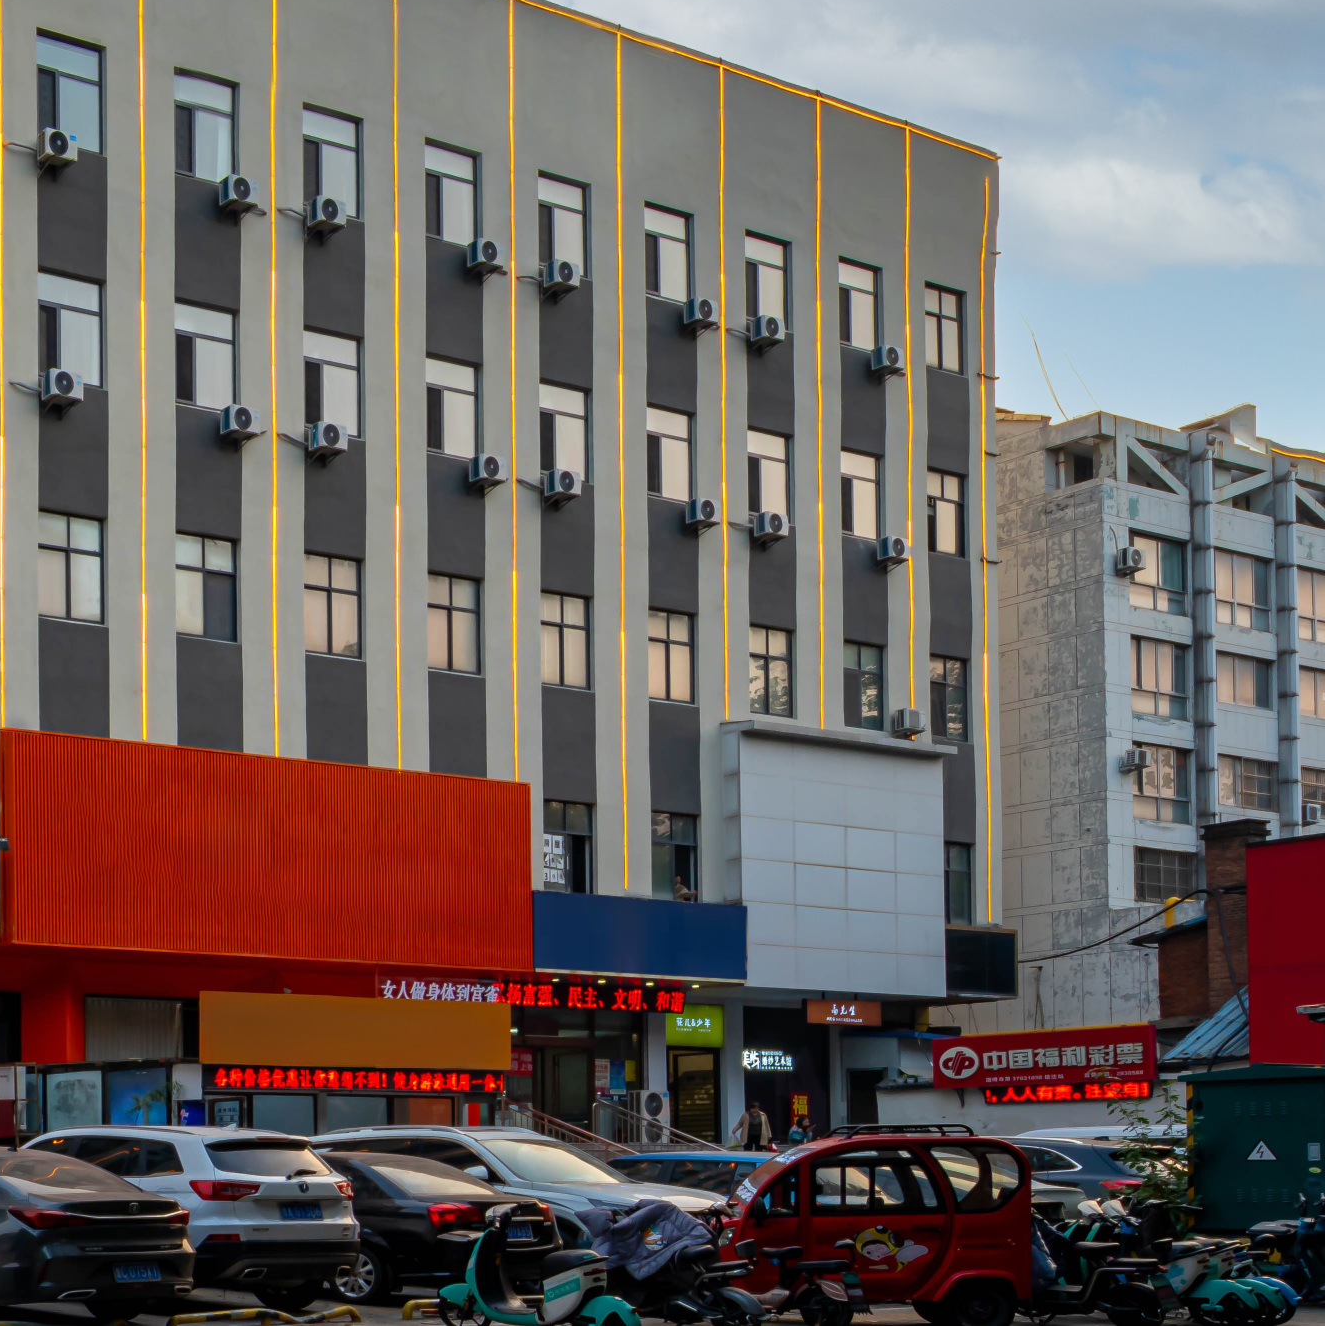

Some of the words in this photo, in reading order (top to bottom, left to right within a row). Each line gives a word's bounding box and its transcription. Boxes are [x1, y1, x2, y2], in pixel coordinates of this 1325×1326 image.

[982, 1042, 1144, 1071] 中国福利彩票
